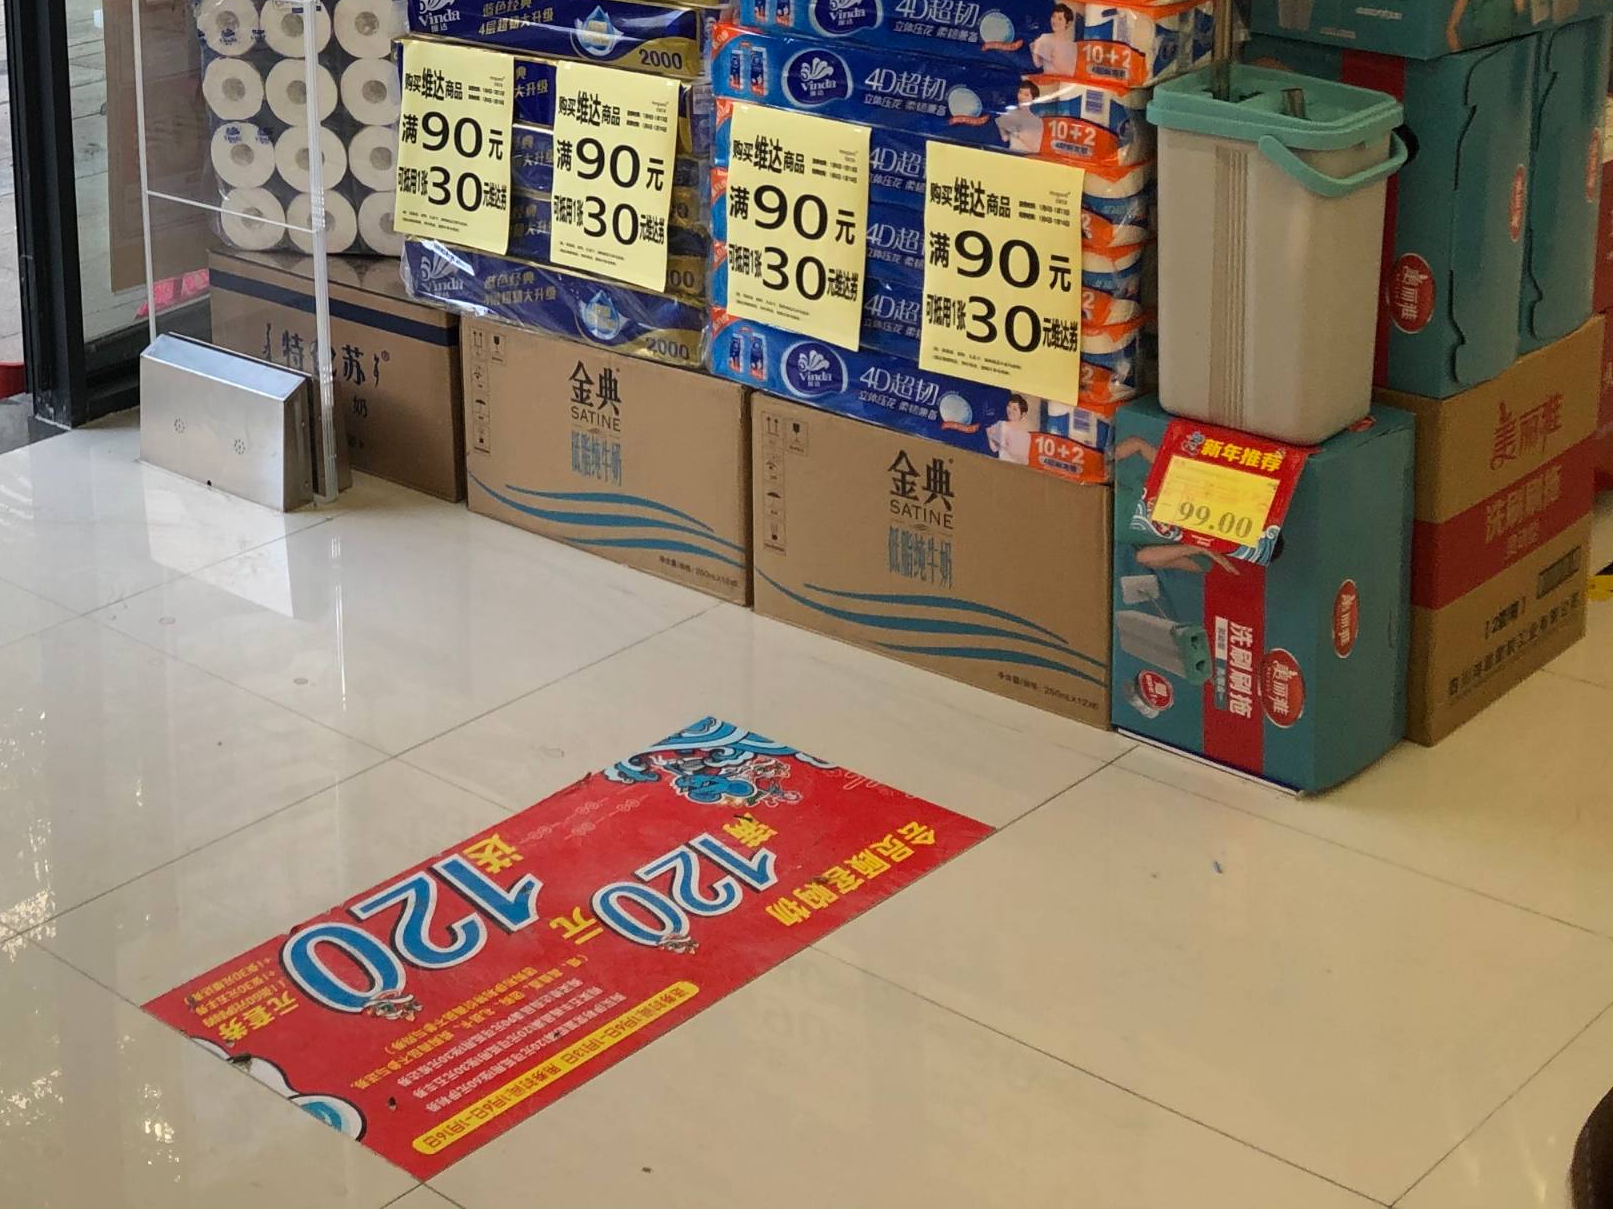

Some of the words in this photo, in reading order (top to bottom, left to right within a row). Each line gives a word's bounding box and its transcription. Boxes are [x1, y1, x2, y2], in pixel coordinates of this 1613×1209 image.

[418, 6, 461, 27] Vinda
[829, 5, 867, 21] Vinda
[893, 20, 934, 37] 立体压花
[638, 47, 683, 70] 2000
[1083, 43, 1133, 68] 10+2
[405, 67, 463, 101] 购买维达商品
[800, 77, 838, 92] Vinda
[864, 67, 948, 102] 4D超韧
[558, 90, 621, 127] 购买维达商品
[863, 93, 902, 110] 立体压花
[1047, 118, 1097, 146] 10+2
[732, 135, 805, 175] 购买维达商品
[869, 147, 926, 177] 4D超
[929, 177, 1011, 219] 购买维达商品
[867, 223, 925, 255] 4D超
[644, 336, 689, 360] 2000
[569, 359, 622, 417] 金典
[797, 368, 833, 384] Vinda
[859, 366, 940, 407] 4D超韧
[858, 390, 896, 409] 立体压花
[570, 405, 622, 433] SATINE
[1034, 437, 1086, 466] 10+2
[1199, 437, 1284, 475] 新年推荐
[888, 449, 955, 511] 金典
[889, 499, 954, 530] SATINE
[1178, 500, 1254, 540] 99.00
[1228, 621, 1254, 719] 洗刷刷拖
[764, 819, 938, 927] 会员顾客购物
